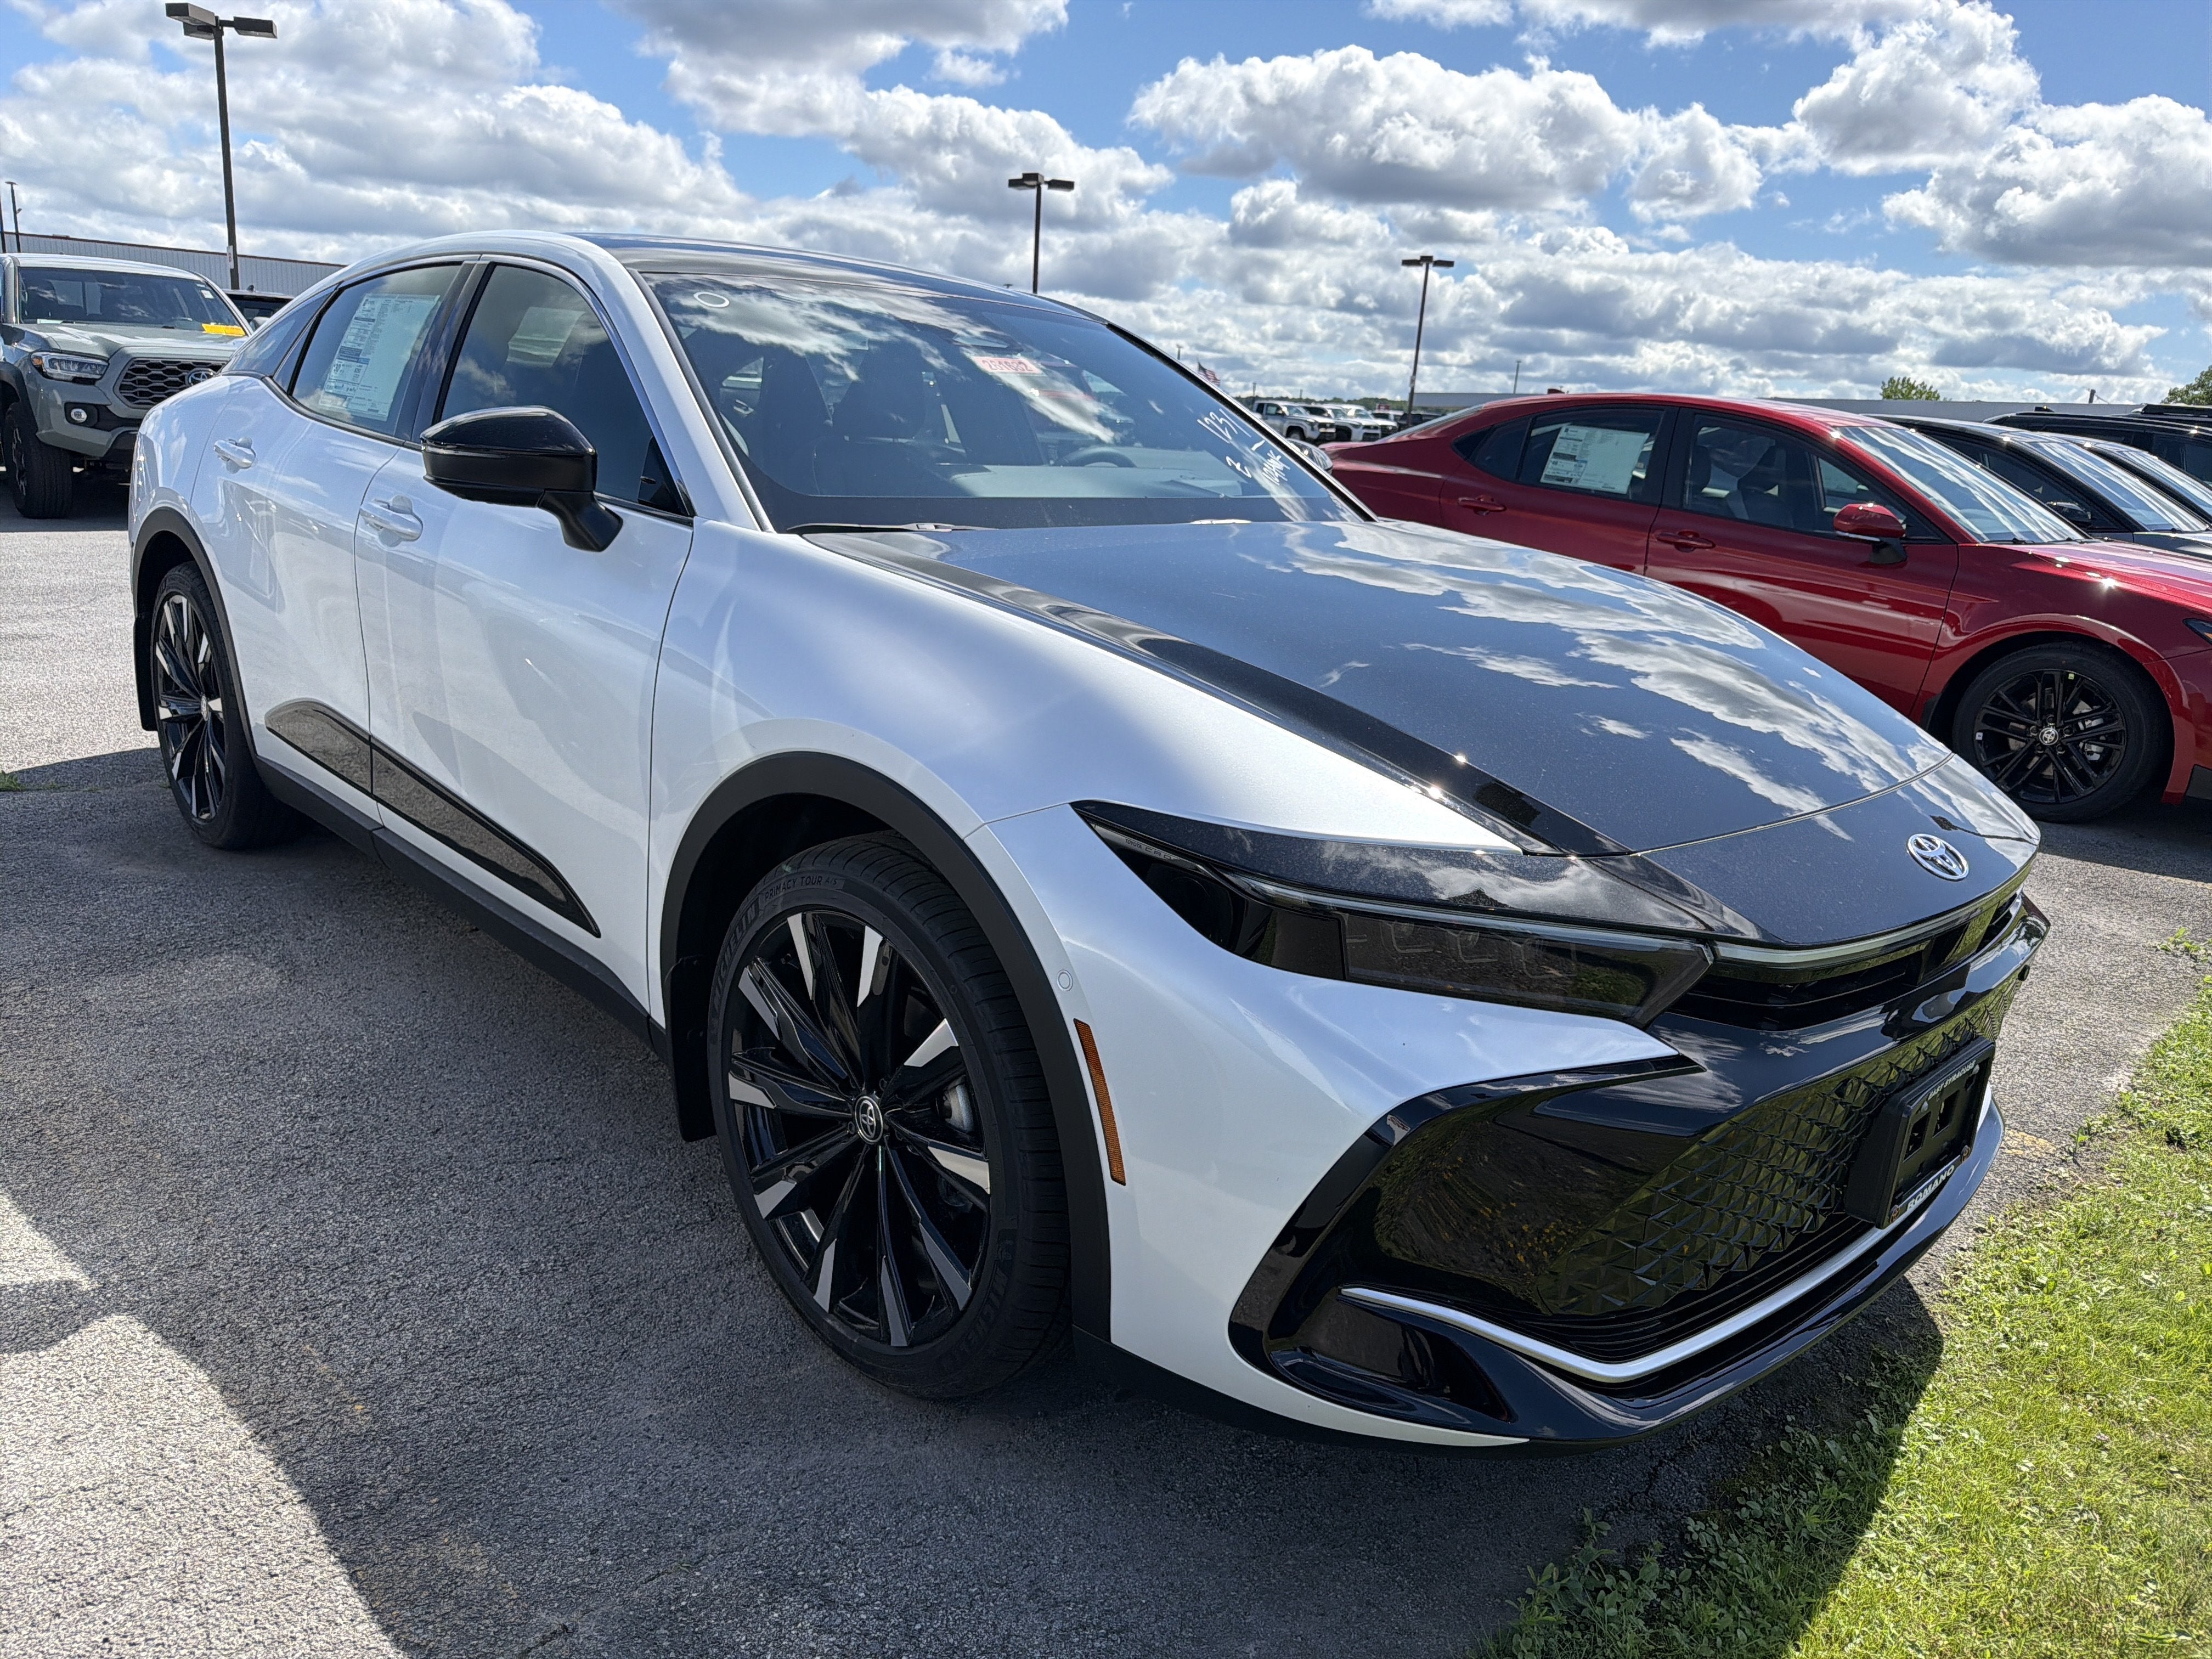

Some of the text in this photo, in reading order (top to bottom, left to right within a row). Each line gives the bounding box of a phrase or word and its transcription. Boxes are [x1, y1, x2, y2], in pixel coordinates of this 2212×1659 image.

[765, 878, 797, 901] PRIMACY
[800, 876, 823, 887] TOUR
[1906, 1165, 1955, 1211] ROMANO
